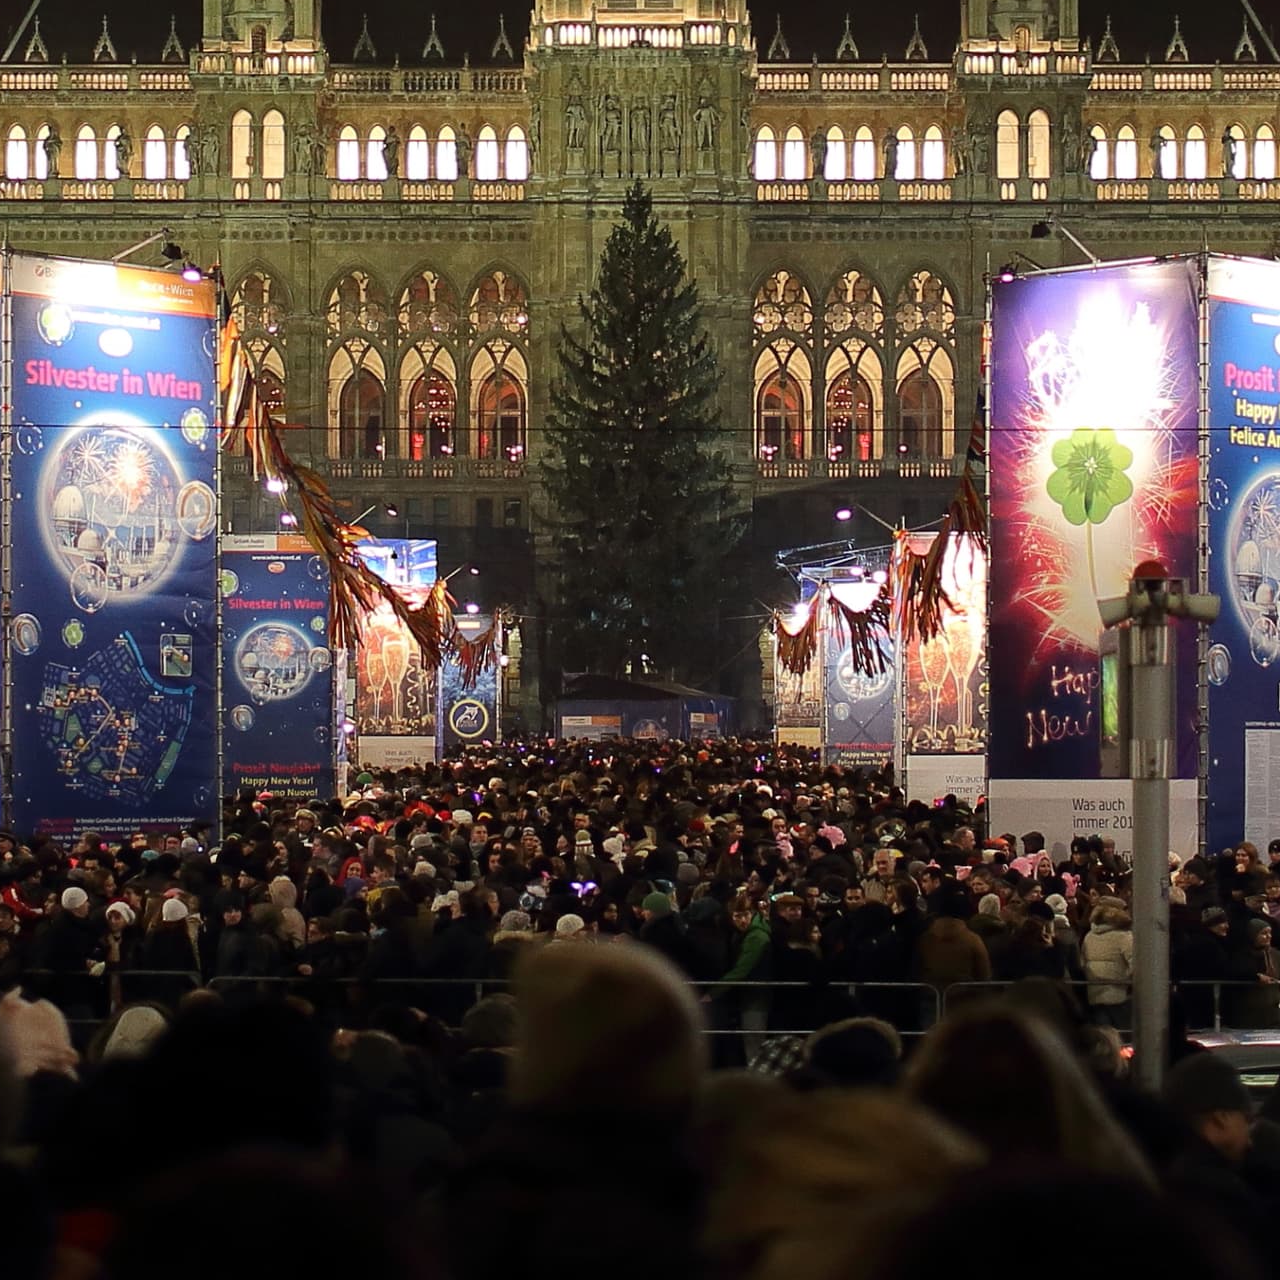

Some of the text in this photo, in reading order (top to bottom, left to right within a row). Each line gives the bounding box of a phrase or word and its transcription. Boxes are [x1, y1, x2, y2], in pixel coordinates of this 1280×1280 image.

[25, 359, 202, 401] Silvester in Wien
[1224, 362, 1275, 392] Prosit
[1236, 398, 1277, 425] Happy
[1230, 426, 1265, 446] Felice
[228, 598, 324, 609] Silvester in Wien
[1051, 665, 1100, 704] Hap
[1026, 709, 1093, 749] New
[241, 776, 314, 787] Happy New Year!
[945, 775, 963, 783] Was
[287, 788, 318, 797] Nuovo!
[945, 785, 974, 793] immer
[1073, 798, 1125, 811] Was auch
[1073, 816, 1134, 828] immer 201
